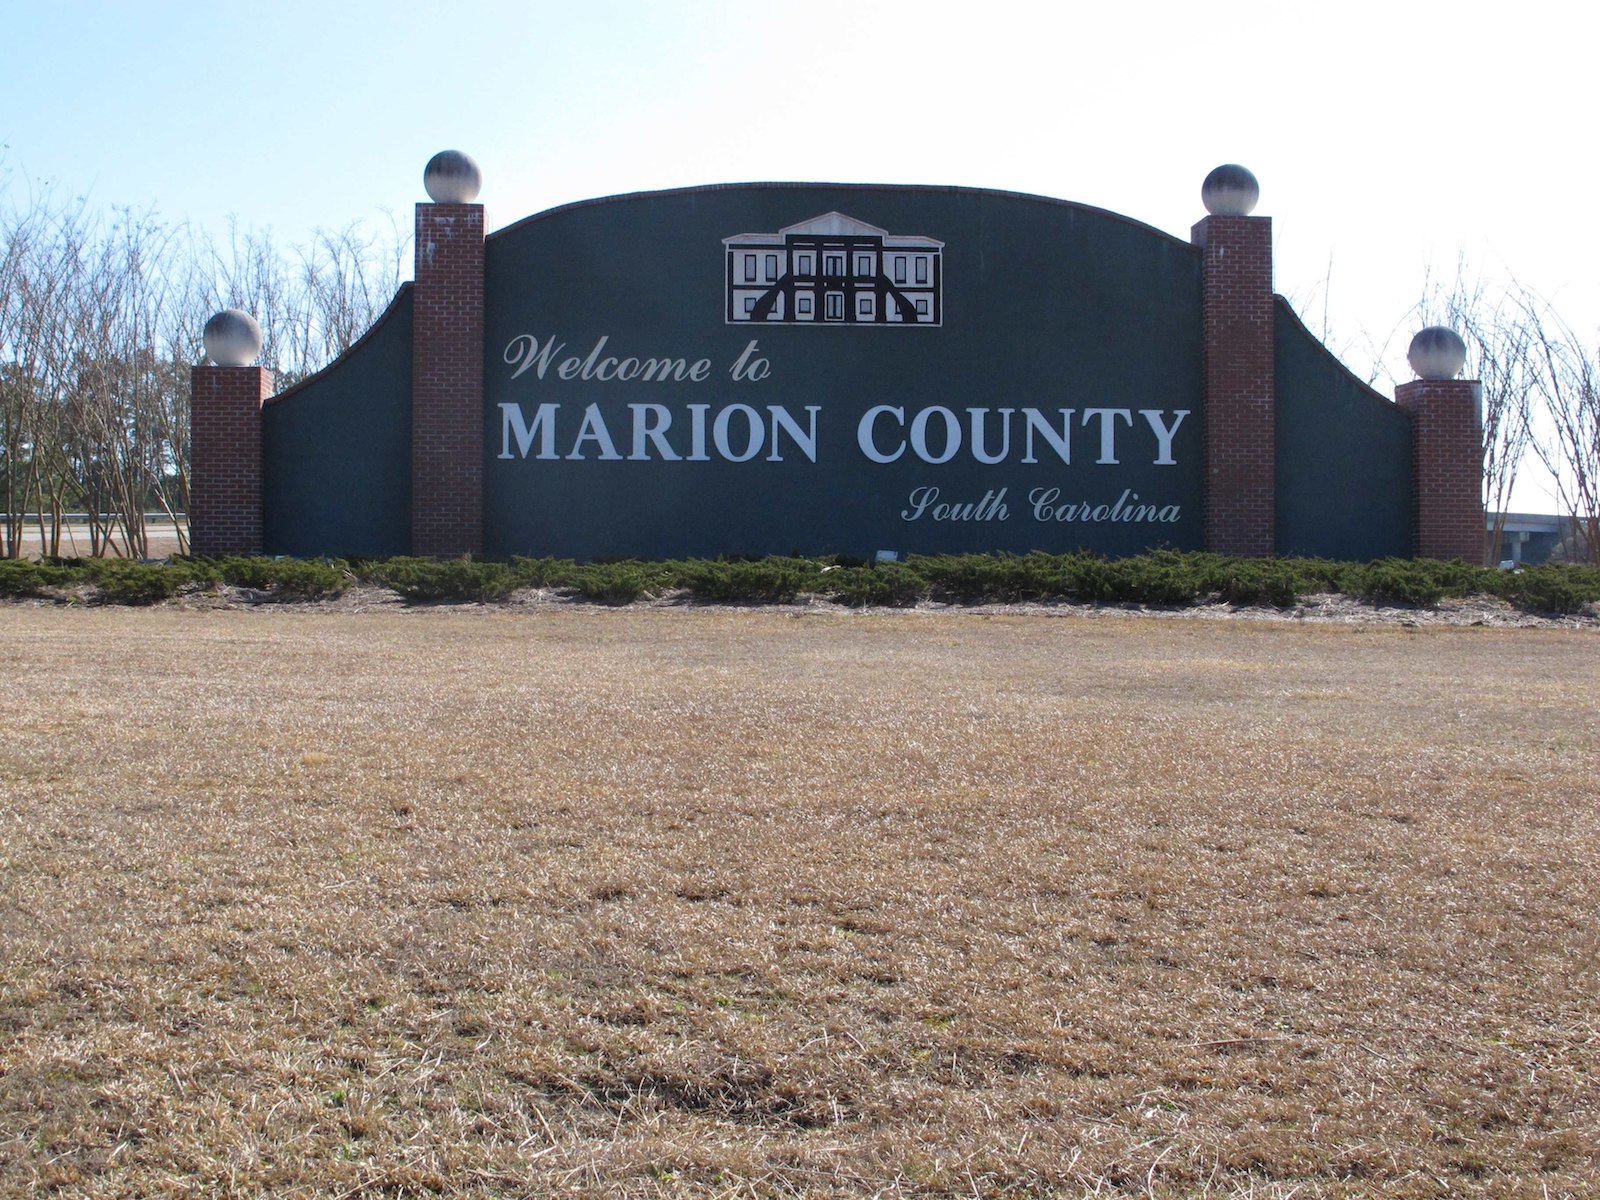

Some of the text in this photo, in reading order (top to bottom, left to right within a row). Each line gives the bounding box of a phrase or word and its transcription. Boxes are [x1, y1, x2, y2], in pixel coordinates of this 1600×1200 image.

[503, 334, 771, 382] Welcome to
[497, 402, 1191, 466] MARION COUNTY
[901, 486, 1182, 524] South Carolina
